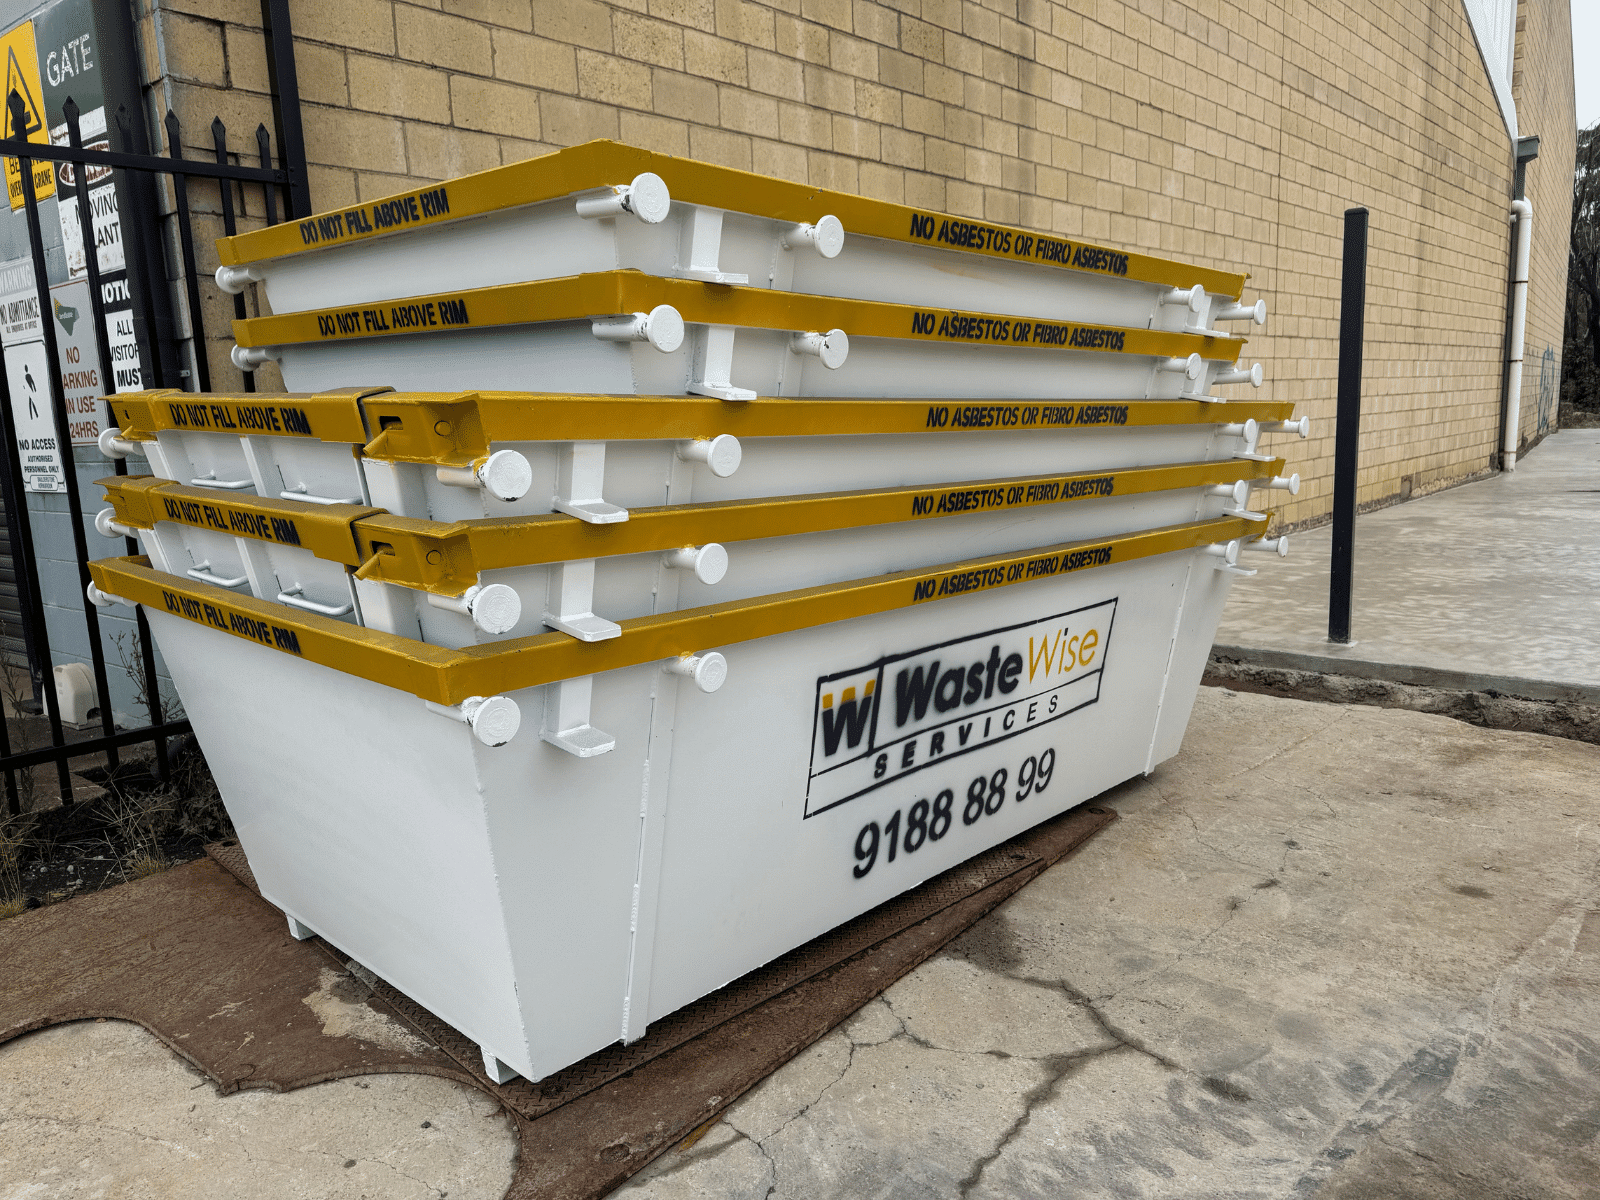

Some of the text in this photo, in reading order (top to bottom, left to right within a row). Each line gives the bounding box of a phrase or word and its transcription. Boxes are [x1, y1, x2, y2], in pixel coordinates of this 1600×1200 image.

[47, 33, 93, 87] GATE
[300, 188, 449, 244] DO NOT FILL ABOVE RIM
[910, 213, 1128, 275] NO ASBESTOS OR FIBRO ASBESTOS
[116, 320, 132, 336] ALL
[317, 299, 469, 336] DO NOT FILL ABOVE RIM
[911, 312, 1125, 350] NO ASBESTOS OR FIBRO ASBESTOS
[66, 346, 80, 364] NO
[63, 370, 98, 390] ARKING
[76, 396, 96, 414] USE
[169, 403, 312, 435] DO NOT FILL ABOVE RIM
[926, 406, 1128, 428] NO ASBESTOS OR FIBRO ASBESTOS
[18, 438, 56, 450] NO ACCESS
[70, 420, 99, 439] 24HRS
[912, 476, 1114, 516] NO ASBESTOS OR FIBRO ASBESTOS
[163, 498, 301, 546] DO NOT FILL ABOVE RIM
[913, 547, 1112, 601] NO ASBESTOS OR FIBRO ASBESTOS
[162, 590, 302, 655] DO NOT FILL ABOVE RIM
[874, 695, 1058, 779] SERVICES
[853, 748, 1056, 879] 9188 88 99
